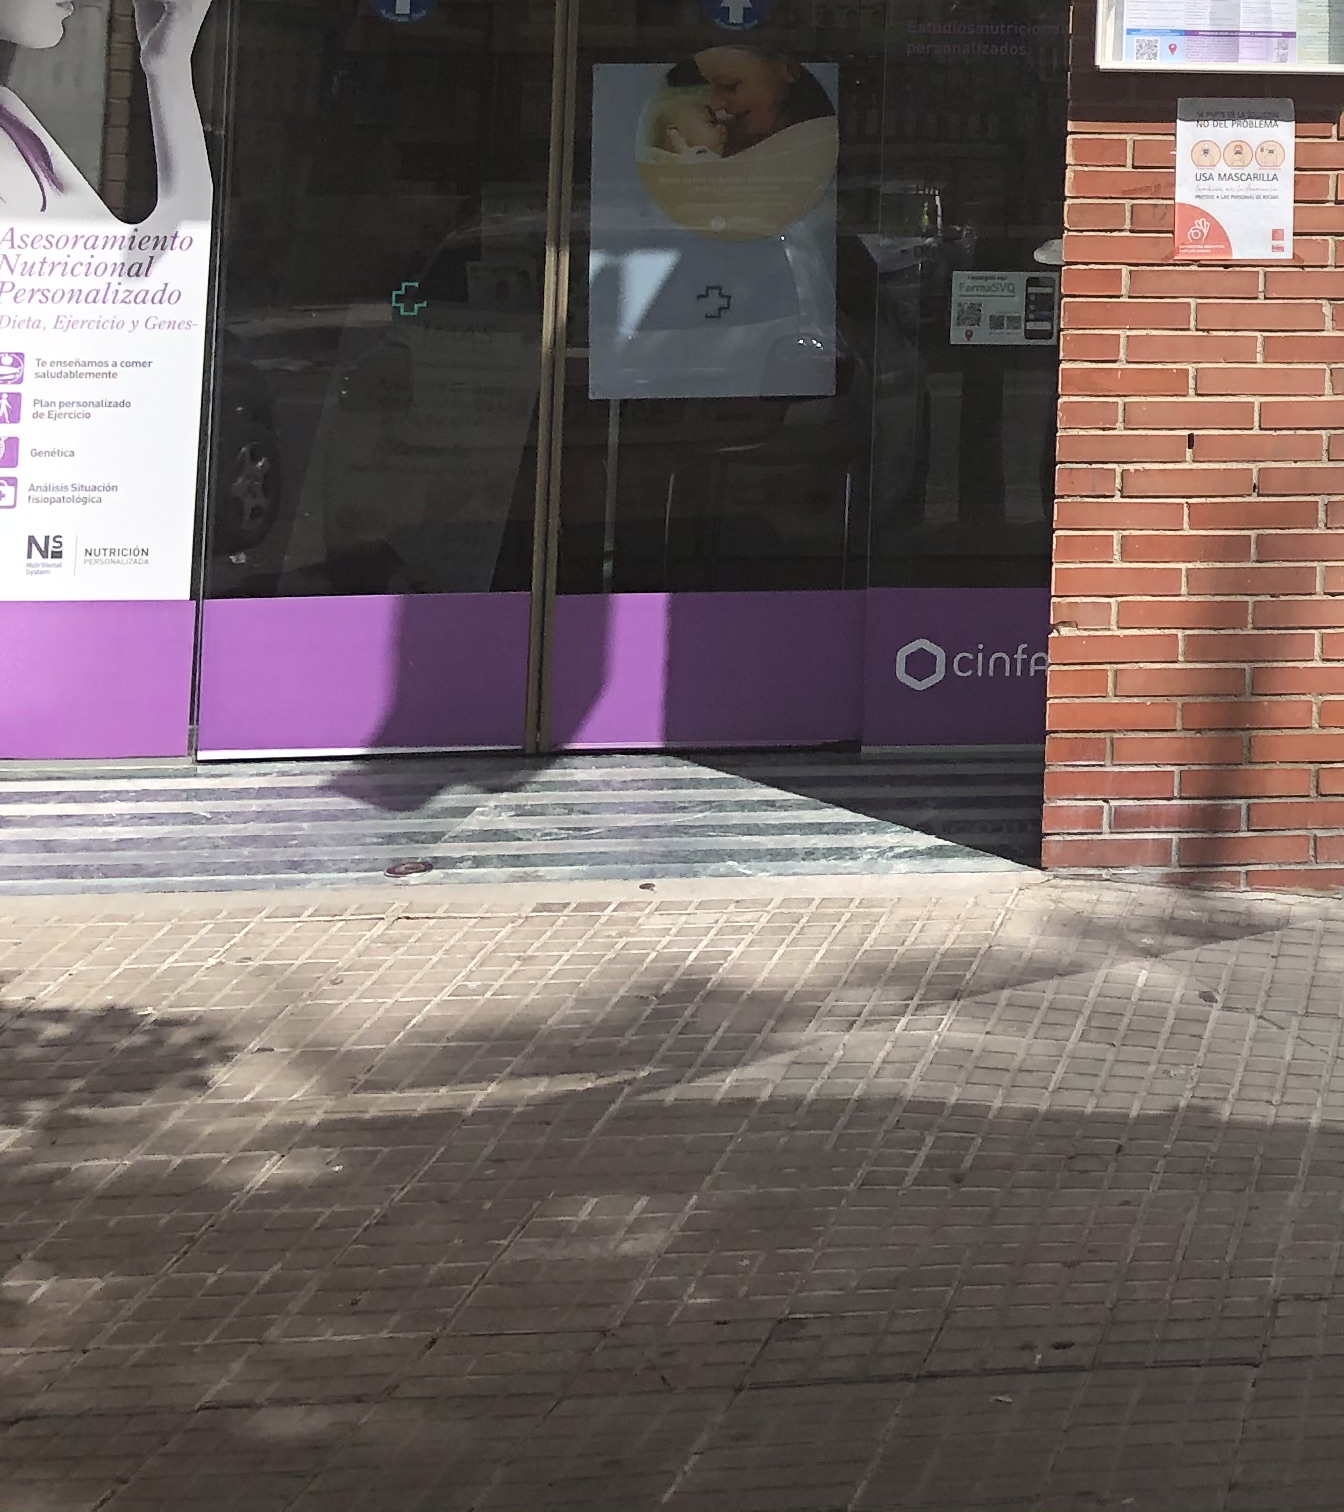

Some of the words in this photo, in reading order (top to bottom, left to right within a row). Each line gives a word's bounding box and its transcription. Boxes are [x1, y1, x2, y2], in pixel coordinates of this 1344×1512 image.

[1195, 173, 1214, 182] USA
[1218, 173, 1279, 182] MASCARILLA
[0, 227, 194, 252] Asesoramiento
[0, 253, 154, 278] Nutricional
[0, 281, 182, 305] Personalizado
[0, 314, 47, 332] Dieta,
[52, 314, 125, 333] Ejercicio
[128, 319, 139, 334] y
[36, 358, 47, 368] Te
[49, 358, 110, 368] enseñamos
[119, 360, 153, 368] comer
[34, 369, 119, 379] saludablemente
[33, 399, 56, 408] Plan
[58, 399, 132, 411] personalizado
[32, 410, 45, 419] de
[47, 410, 91, 421] Ejercicio
[30, 448, 75, 458] Genética
[28, 483, 69, 493] Análisis
[71, 483, 118, 493] Situación
[28, 494, 102, 506] fisiopatológica
[84, 545, 149, 557] NUTRICIÓN
